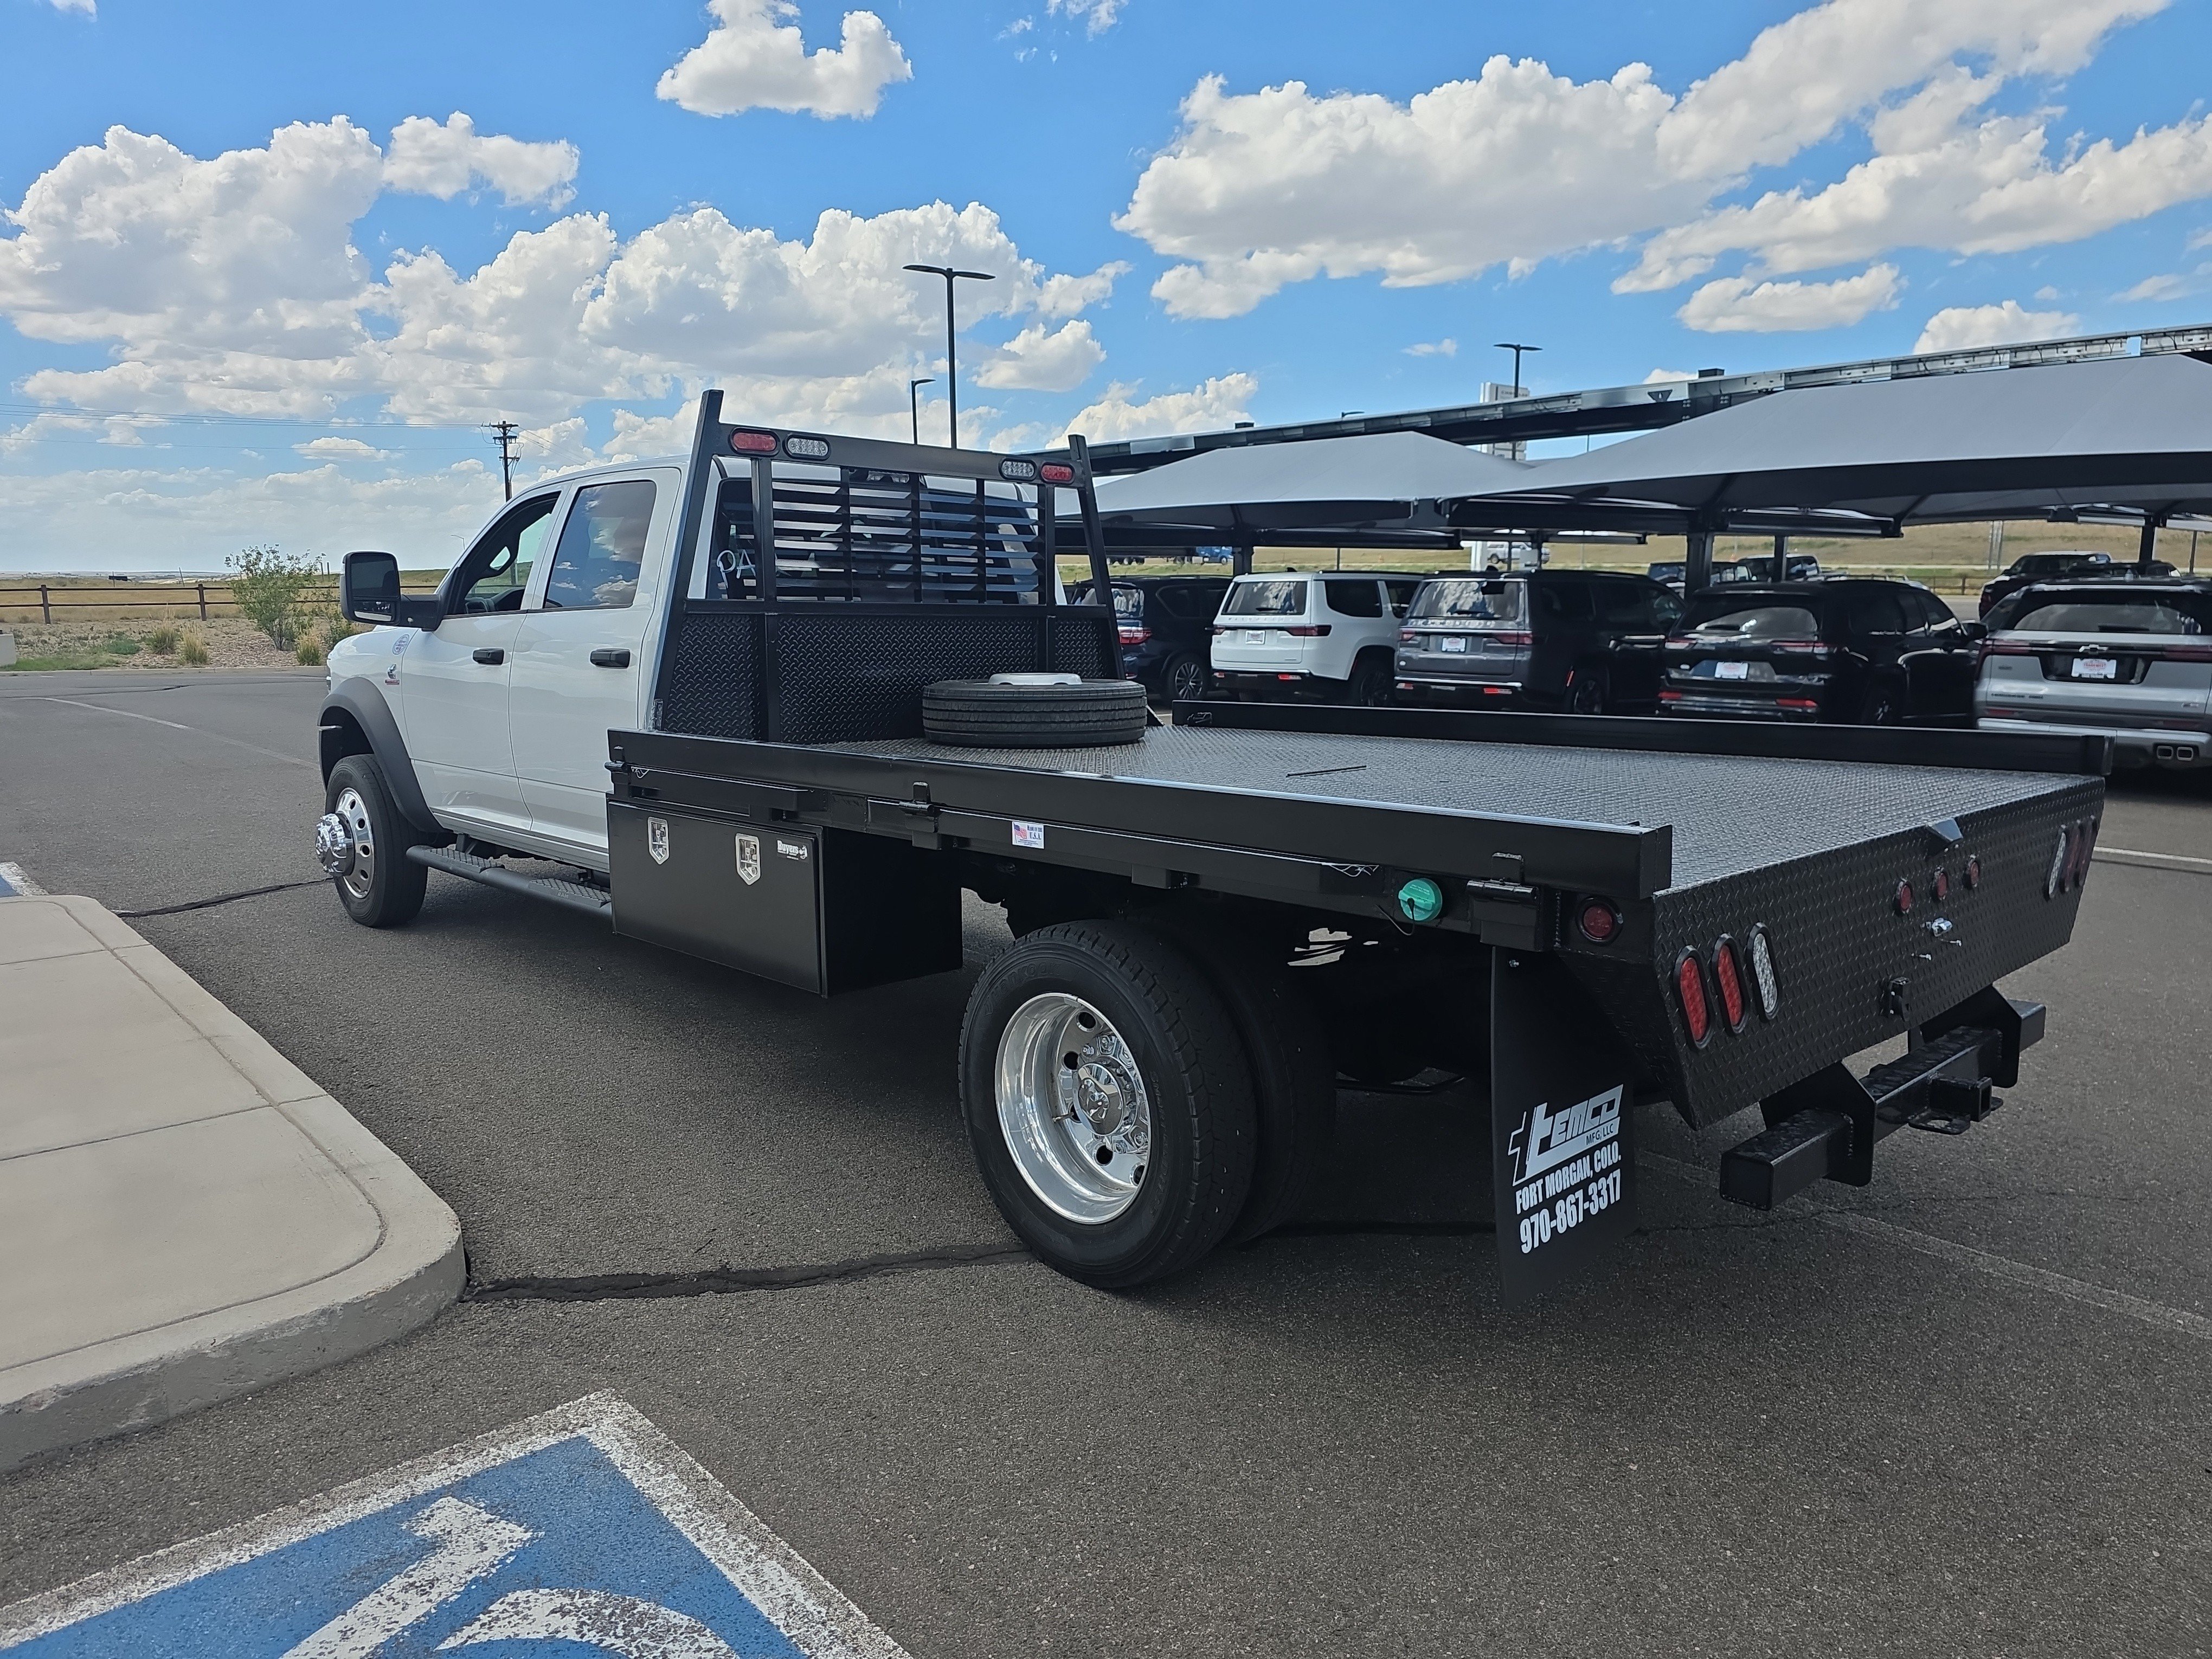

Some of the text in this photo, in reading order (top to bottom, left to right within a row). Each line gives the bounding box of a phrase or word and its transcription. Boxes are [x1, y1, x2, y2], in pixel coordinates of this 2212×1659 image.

[777, 840, 799, 854] Buyers
[1603, 1123, 1614, 1139] LLC
[1516, 1141, 1621, 1214] FORT MORGAN, COLO.
[1520, 1168, 1621, 1253] 970-867-3317
